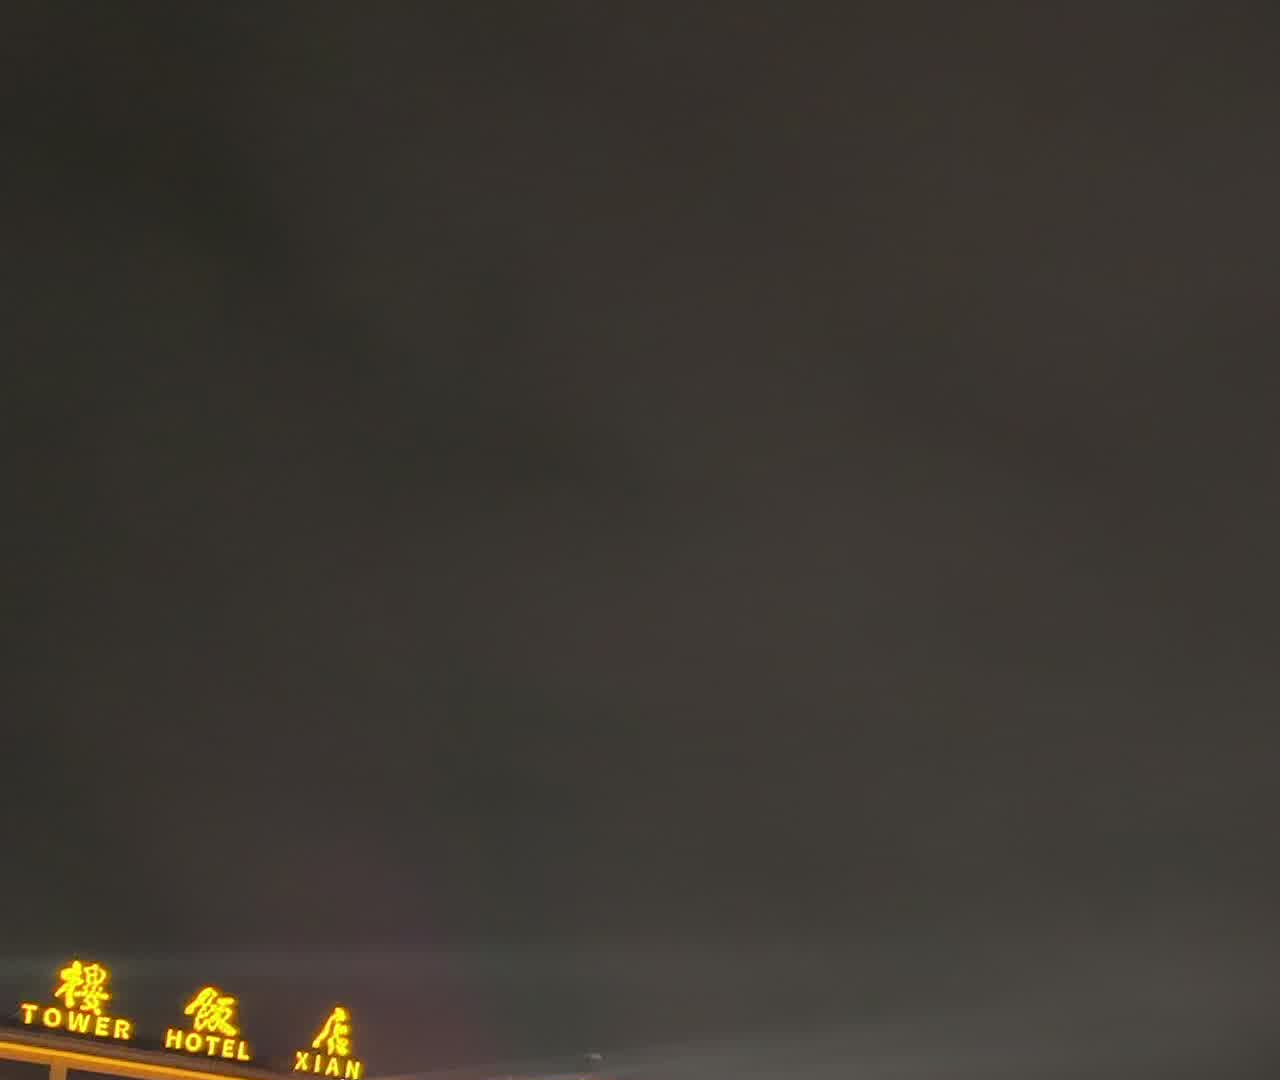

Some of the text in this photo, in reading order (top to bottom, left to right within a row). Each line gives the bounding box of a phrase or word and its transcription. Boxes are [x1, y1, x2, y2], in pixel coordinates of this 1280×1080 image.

[20, 1002, 361, 1080] TOWER HOTEL XIAN
